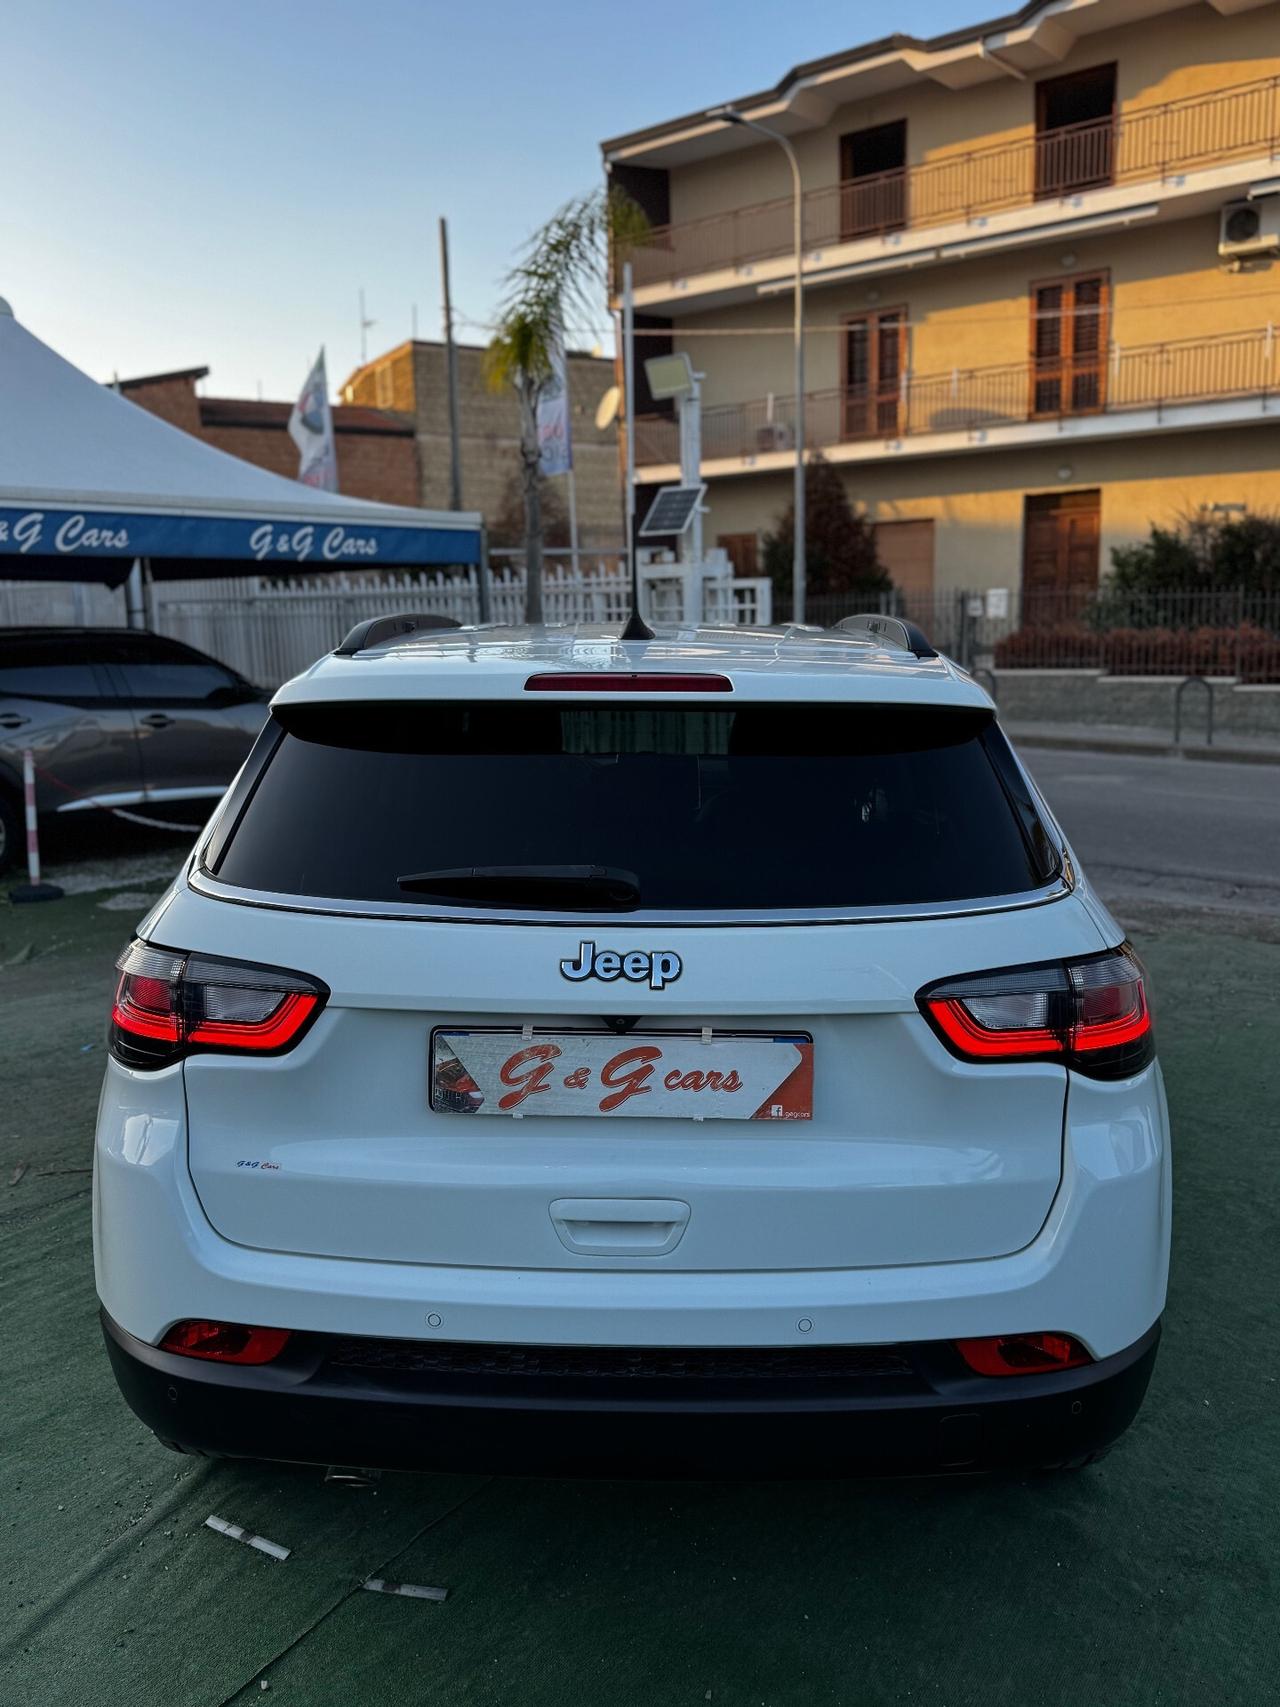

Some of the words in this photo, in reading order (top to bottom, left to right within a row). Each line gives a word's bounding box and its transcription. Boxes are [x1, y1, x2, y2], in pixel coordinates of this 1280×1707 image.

[55, 514, 129, 552] Cars
[322, 526, 378, 559] Cars
[560, 940, 682, 990] Jeep
[498, 1044, 563, 1111] G
[563, 1067, 592, 1089] &
[599, 1046, 663, 1112] G
[664, 1069, 743, 1093] cars
